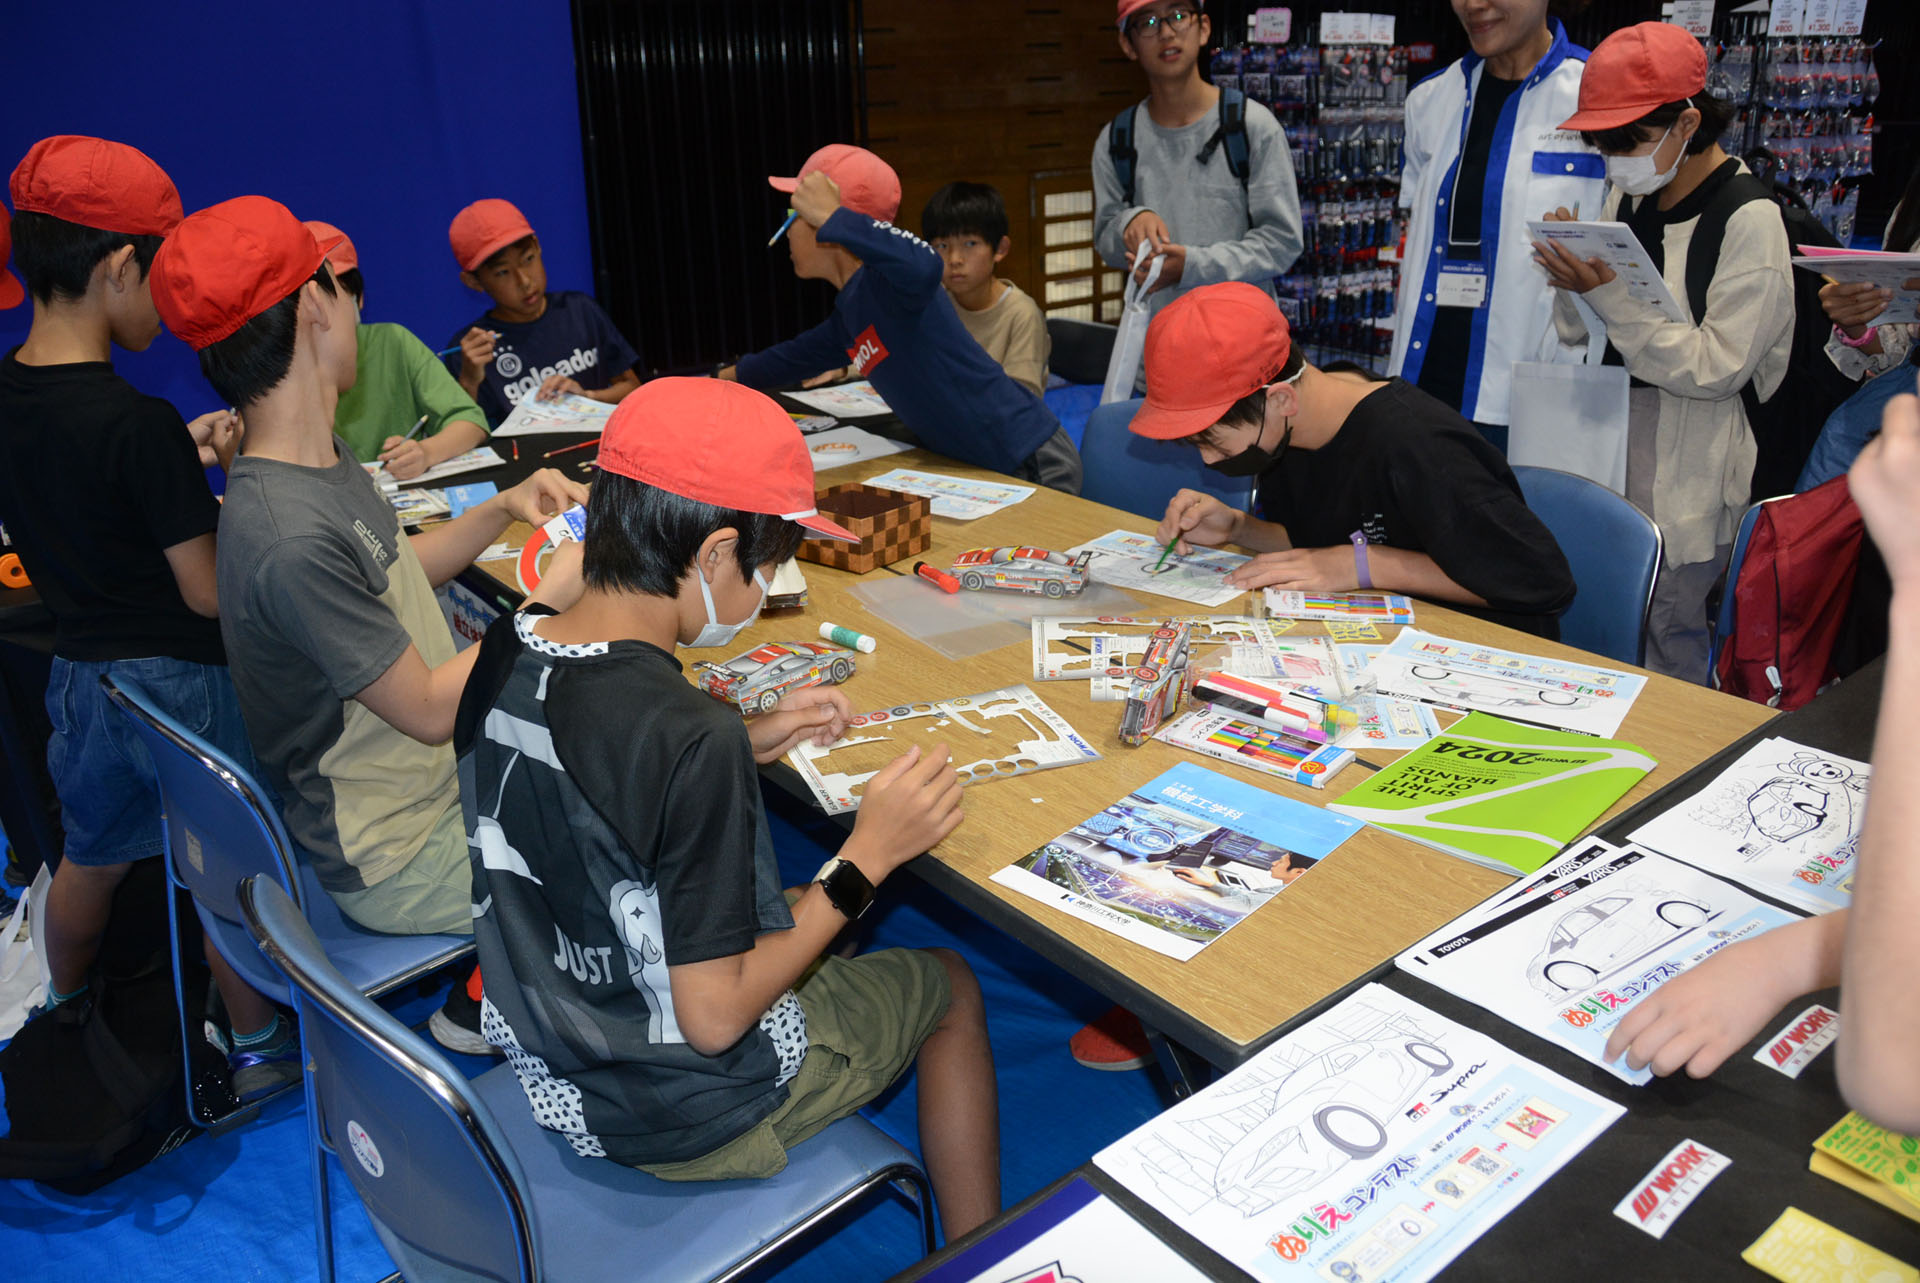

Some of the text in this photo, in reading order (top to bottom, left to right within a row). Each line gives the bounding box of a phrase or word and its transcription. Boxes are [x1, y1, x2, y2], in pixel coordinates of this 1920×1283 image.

[1432, 741, 1545, 766] 2024
[1373, 785, 1418, 800] THE
[1384, 778, 1461, 798] SPIRIT
[1399, 772, 1473, 791] OF ALL
[1406, 765, 1500, 785] BRANDS
[1437, 936, 1472, 954] TOYOTA
[1581, 862, 1617, 884] YARIS
[553, 922, 614, 985] JUST
[1785, 1006, 1837, 1046] WORK
[1430, 1060, 1488, 1105] Supra
[1651, 1143, 1709, 1194] WORK
[1269, 1155, 1419, 1261] ぬりえコンテスト
